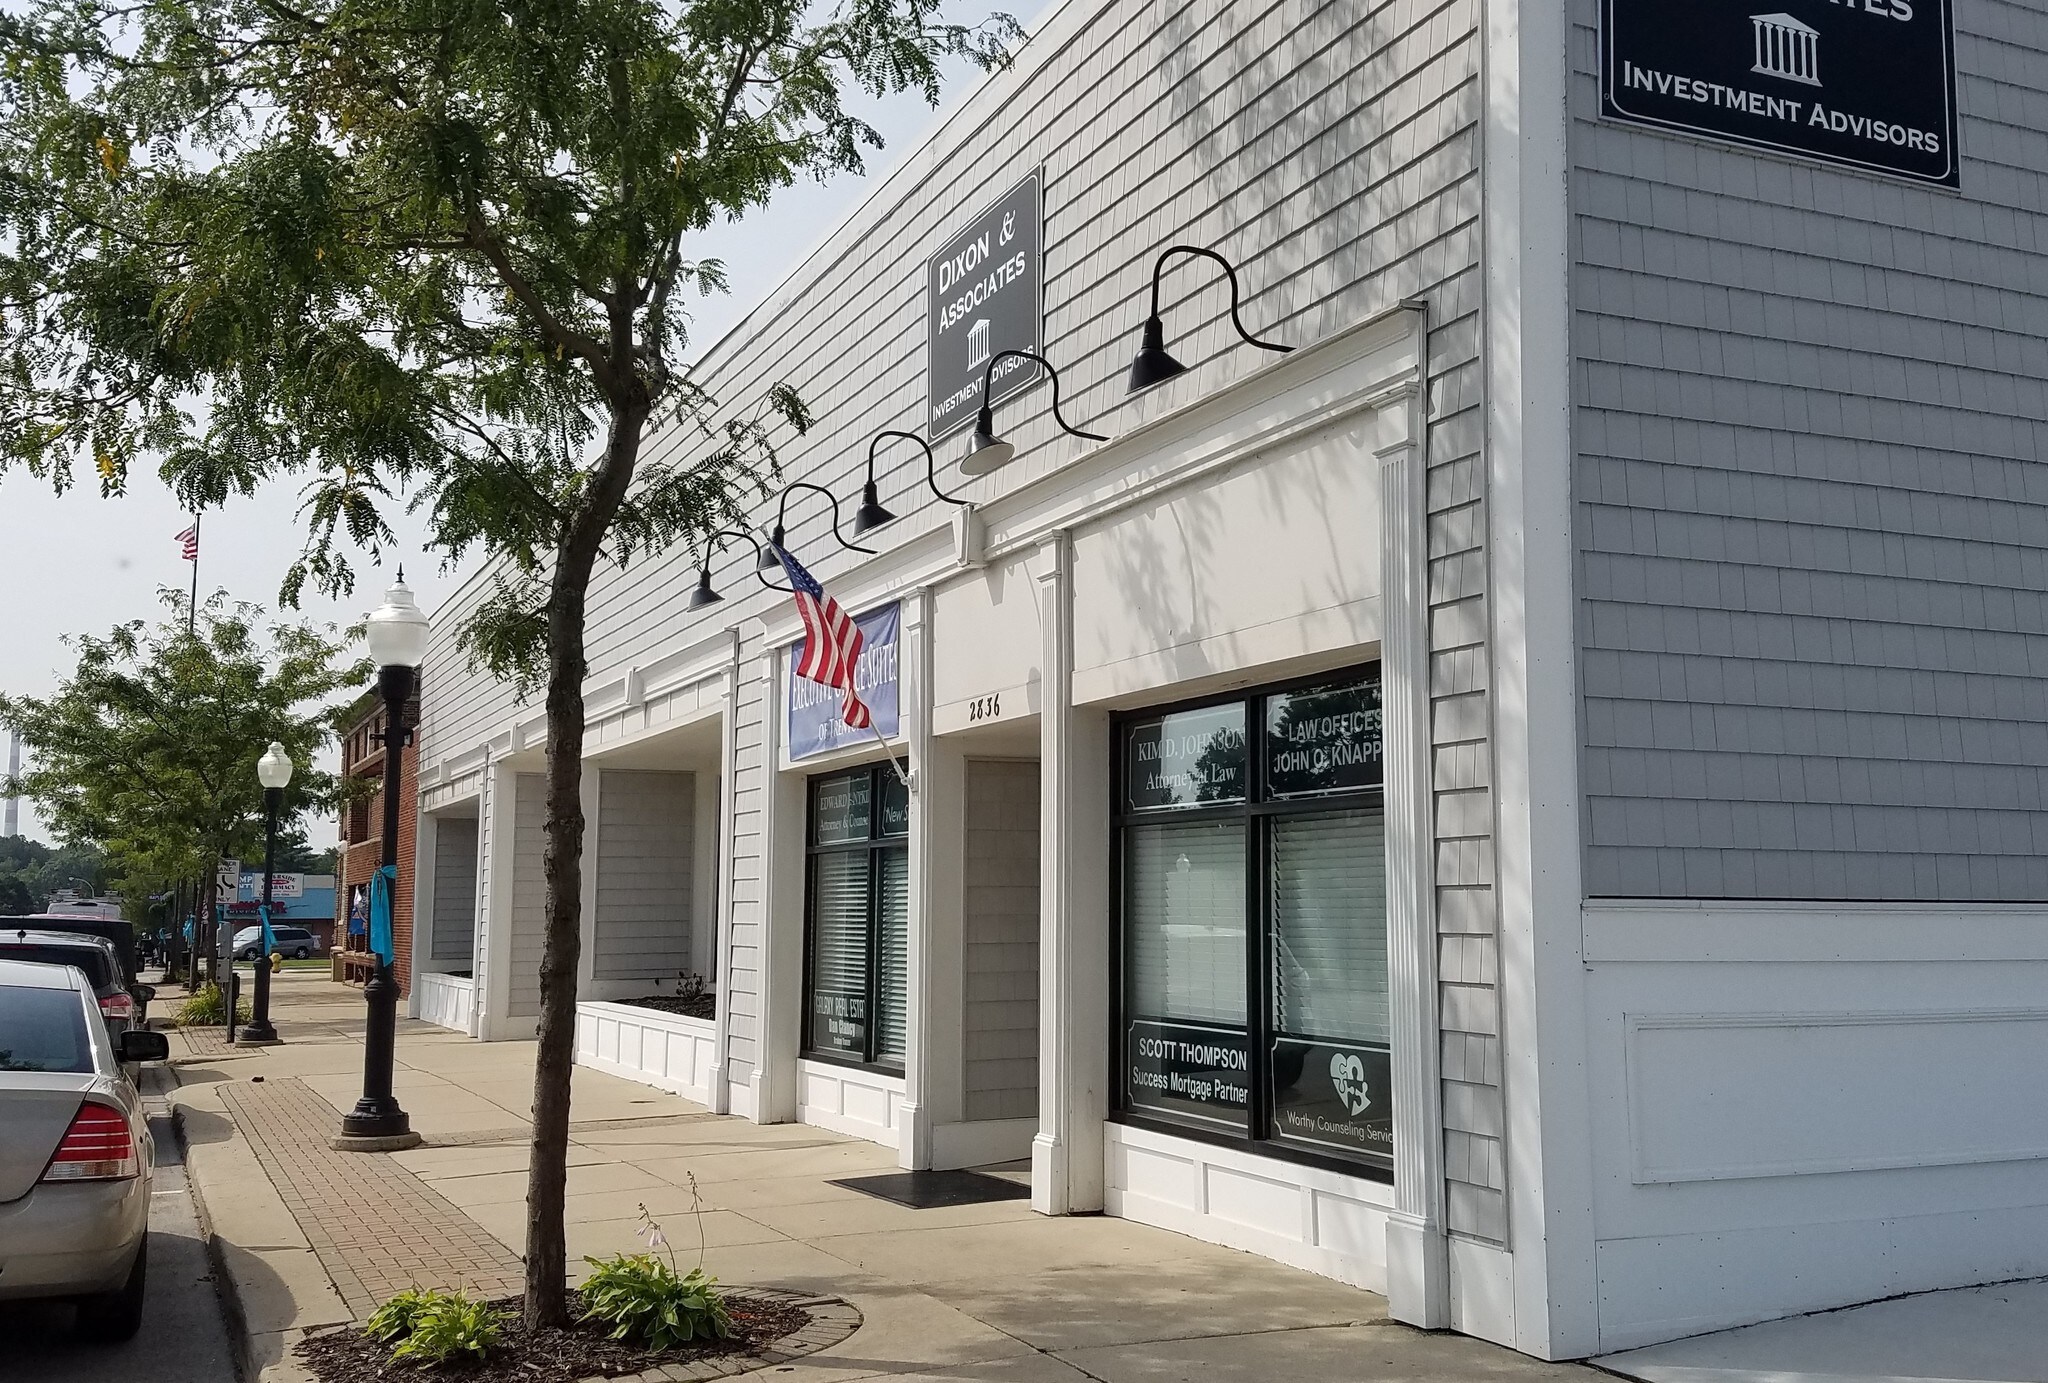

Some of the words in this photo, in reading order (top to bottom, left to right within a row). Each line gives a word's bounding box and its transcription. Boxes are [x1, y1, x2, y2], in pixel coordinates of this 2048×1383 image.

[1623, 60, 1801, 122] INVESTMENT
[1808, 103, 1940, 153] ADVISORS
[938, 231, 990, 295] DIXON
[999, 210, 1016, 246] &
[938, 251, 1026, 335] ASSOCIATES
[933, 376, 983, 422] INVESTMENT
[990, 345, 1034, 384] DVISORS
[969, 693, 1000, 722] 2836
[818, 722, 828, 741] OF
[829, 719, 860, 738] TREN
[1288, 719, 1318, 742] LAW
[1322, 709, 1382, 737] OFFICES
[1138, 741, 1162, 762] KIM
[1165, 738, 1178, 758] D.
[1180, 727, 1246, 760] JOHNSON
[1274, 750, 1309, 773] JOHN
[1332, 741, 1382, 766] KNAPP
[1146, 771, 1194, 790] Attorney
[1211, 763, 1236, 783] Law
[886, 807, 903, 823] New
[1139, 1037, 1177, 1060] SCOTT
[1179, 1042, 1247, 1071] THOMPSON
[1133, 1065, 1168, 1089] Success
[1171, 1072, 1211, 1100] Mortgage
[1214, 1078, 1248, 1104] Partner
[1287, 1110, 1315, 1132] Worthy
[1317, 1116, 1364, 1141] Counseling
